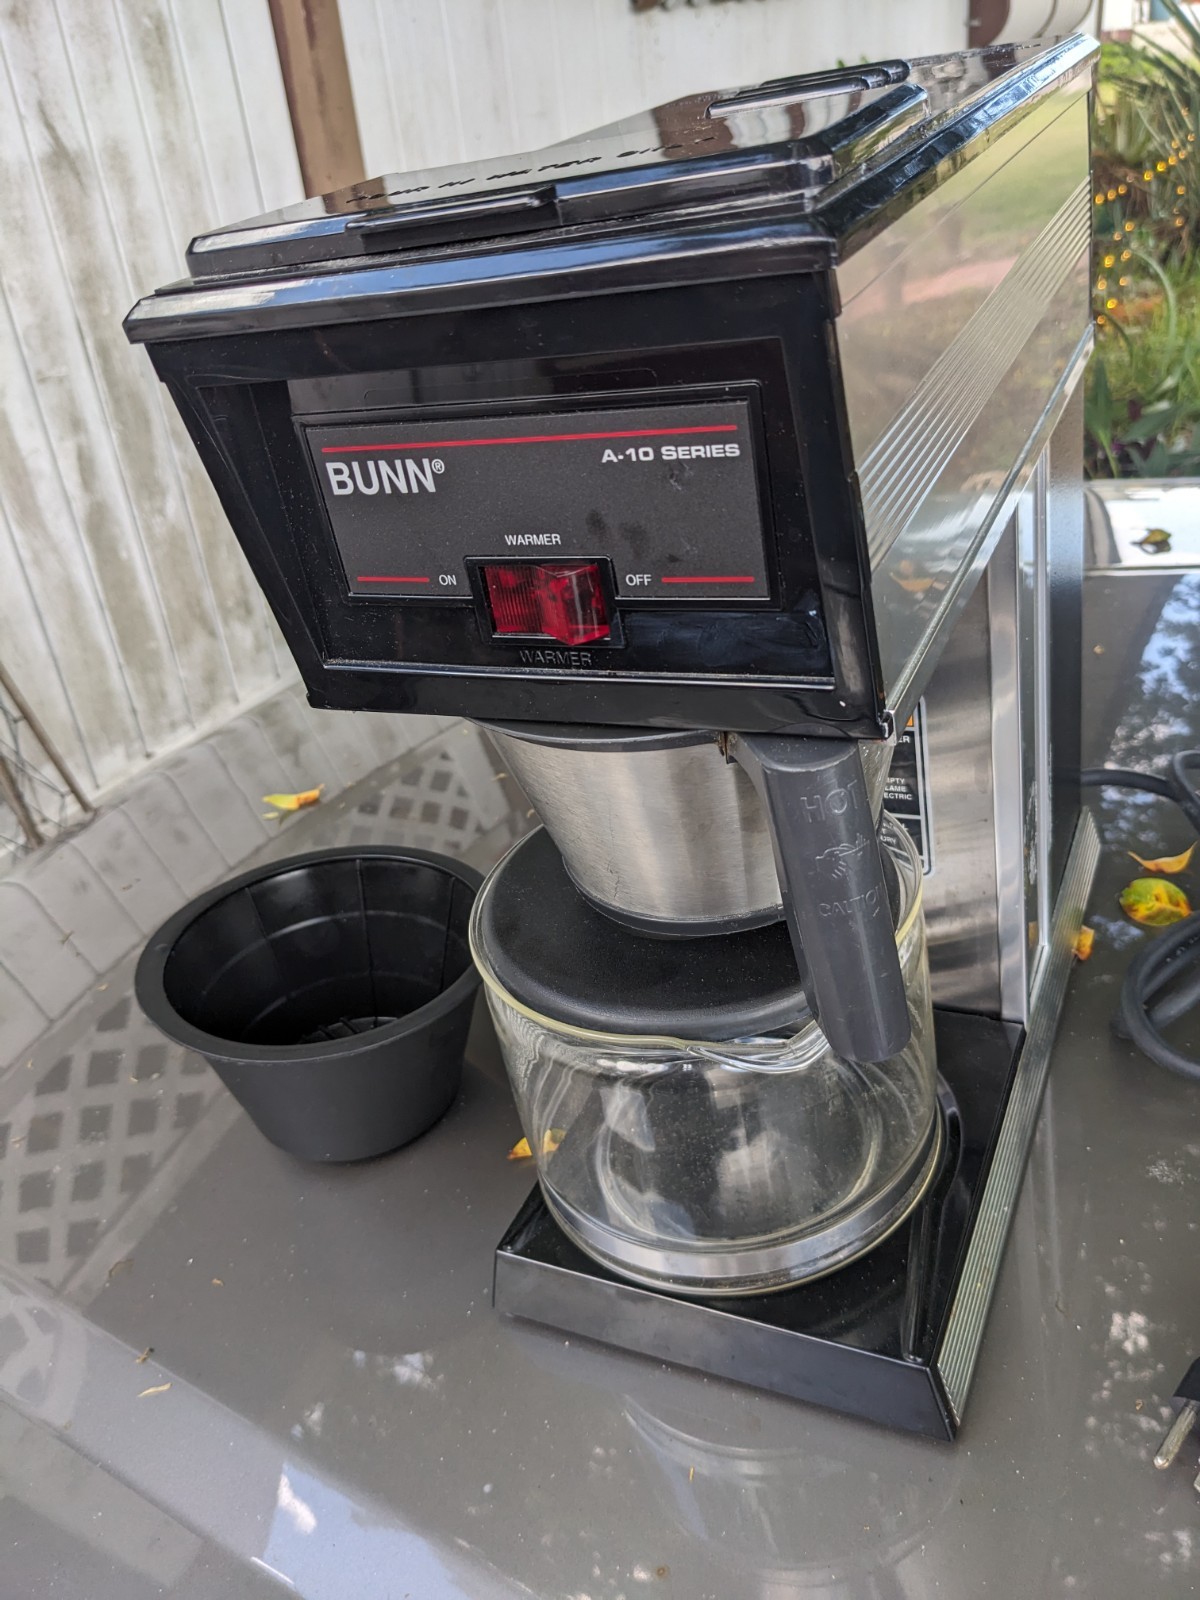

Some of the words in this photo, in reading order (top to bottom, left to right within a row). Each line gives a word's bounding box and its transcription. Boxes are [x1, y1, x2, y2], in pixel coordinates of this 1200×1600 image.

[601, 447, 655, 463] A-10
[660, 443, 740, 460] SERIES
[504, 533, 562, 546] WARMER
[438, 574, 457, 586] ON
[625, 574, 652, 586] OFF
[519, 650, 592, 666] WARMER
[800, 779, 858, 823] HOT
